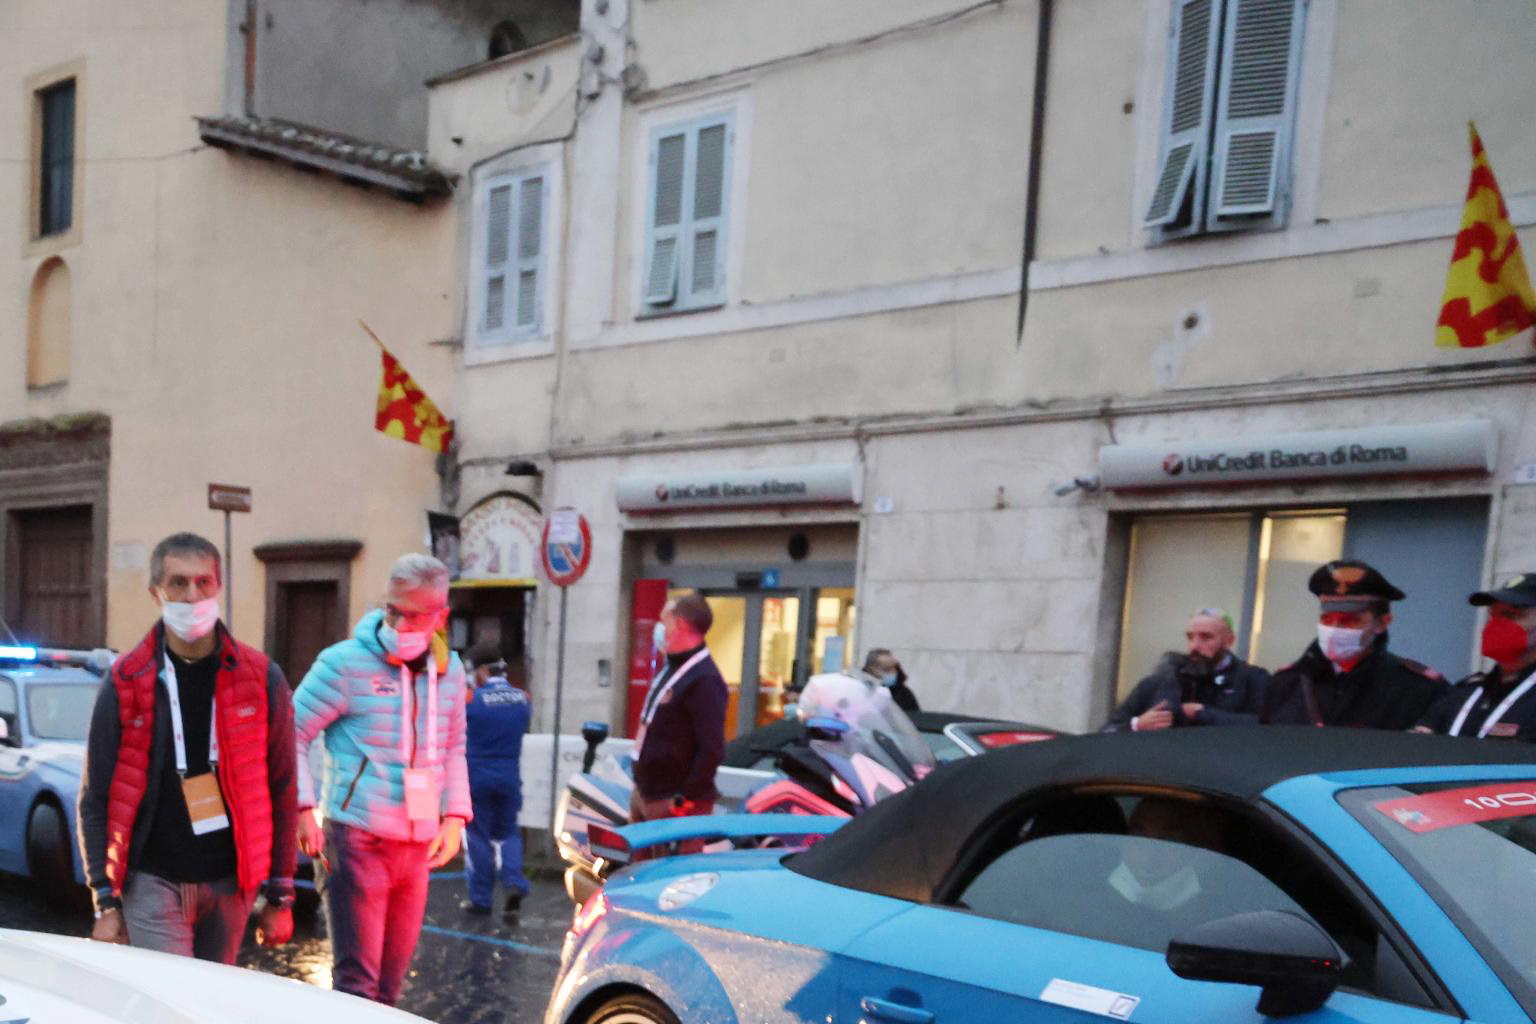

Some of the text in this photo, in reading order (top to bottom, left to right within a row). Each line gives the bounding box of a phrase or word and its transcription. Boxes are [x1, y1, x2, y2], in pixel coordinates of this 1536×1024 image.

[1186, 443, 1407, 473] UniCredit Banca di Roma
[1464, 791, 1536, 810] 100
